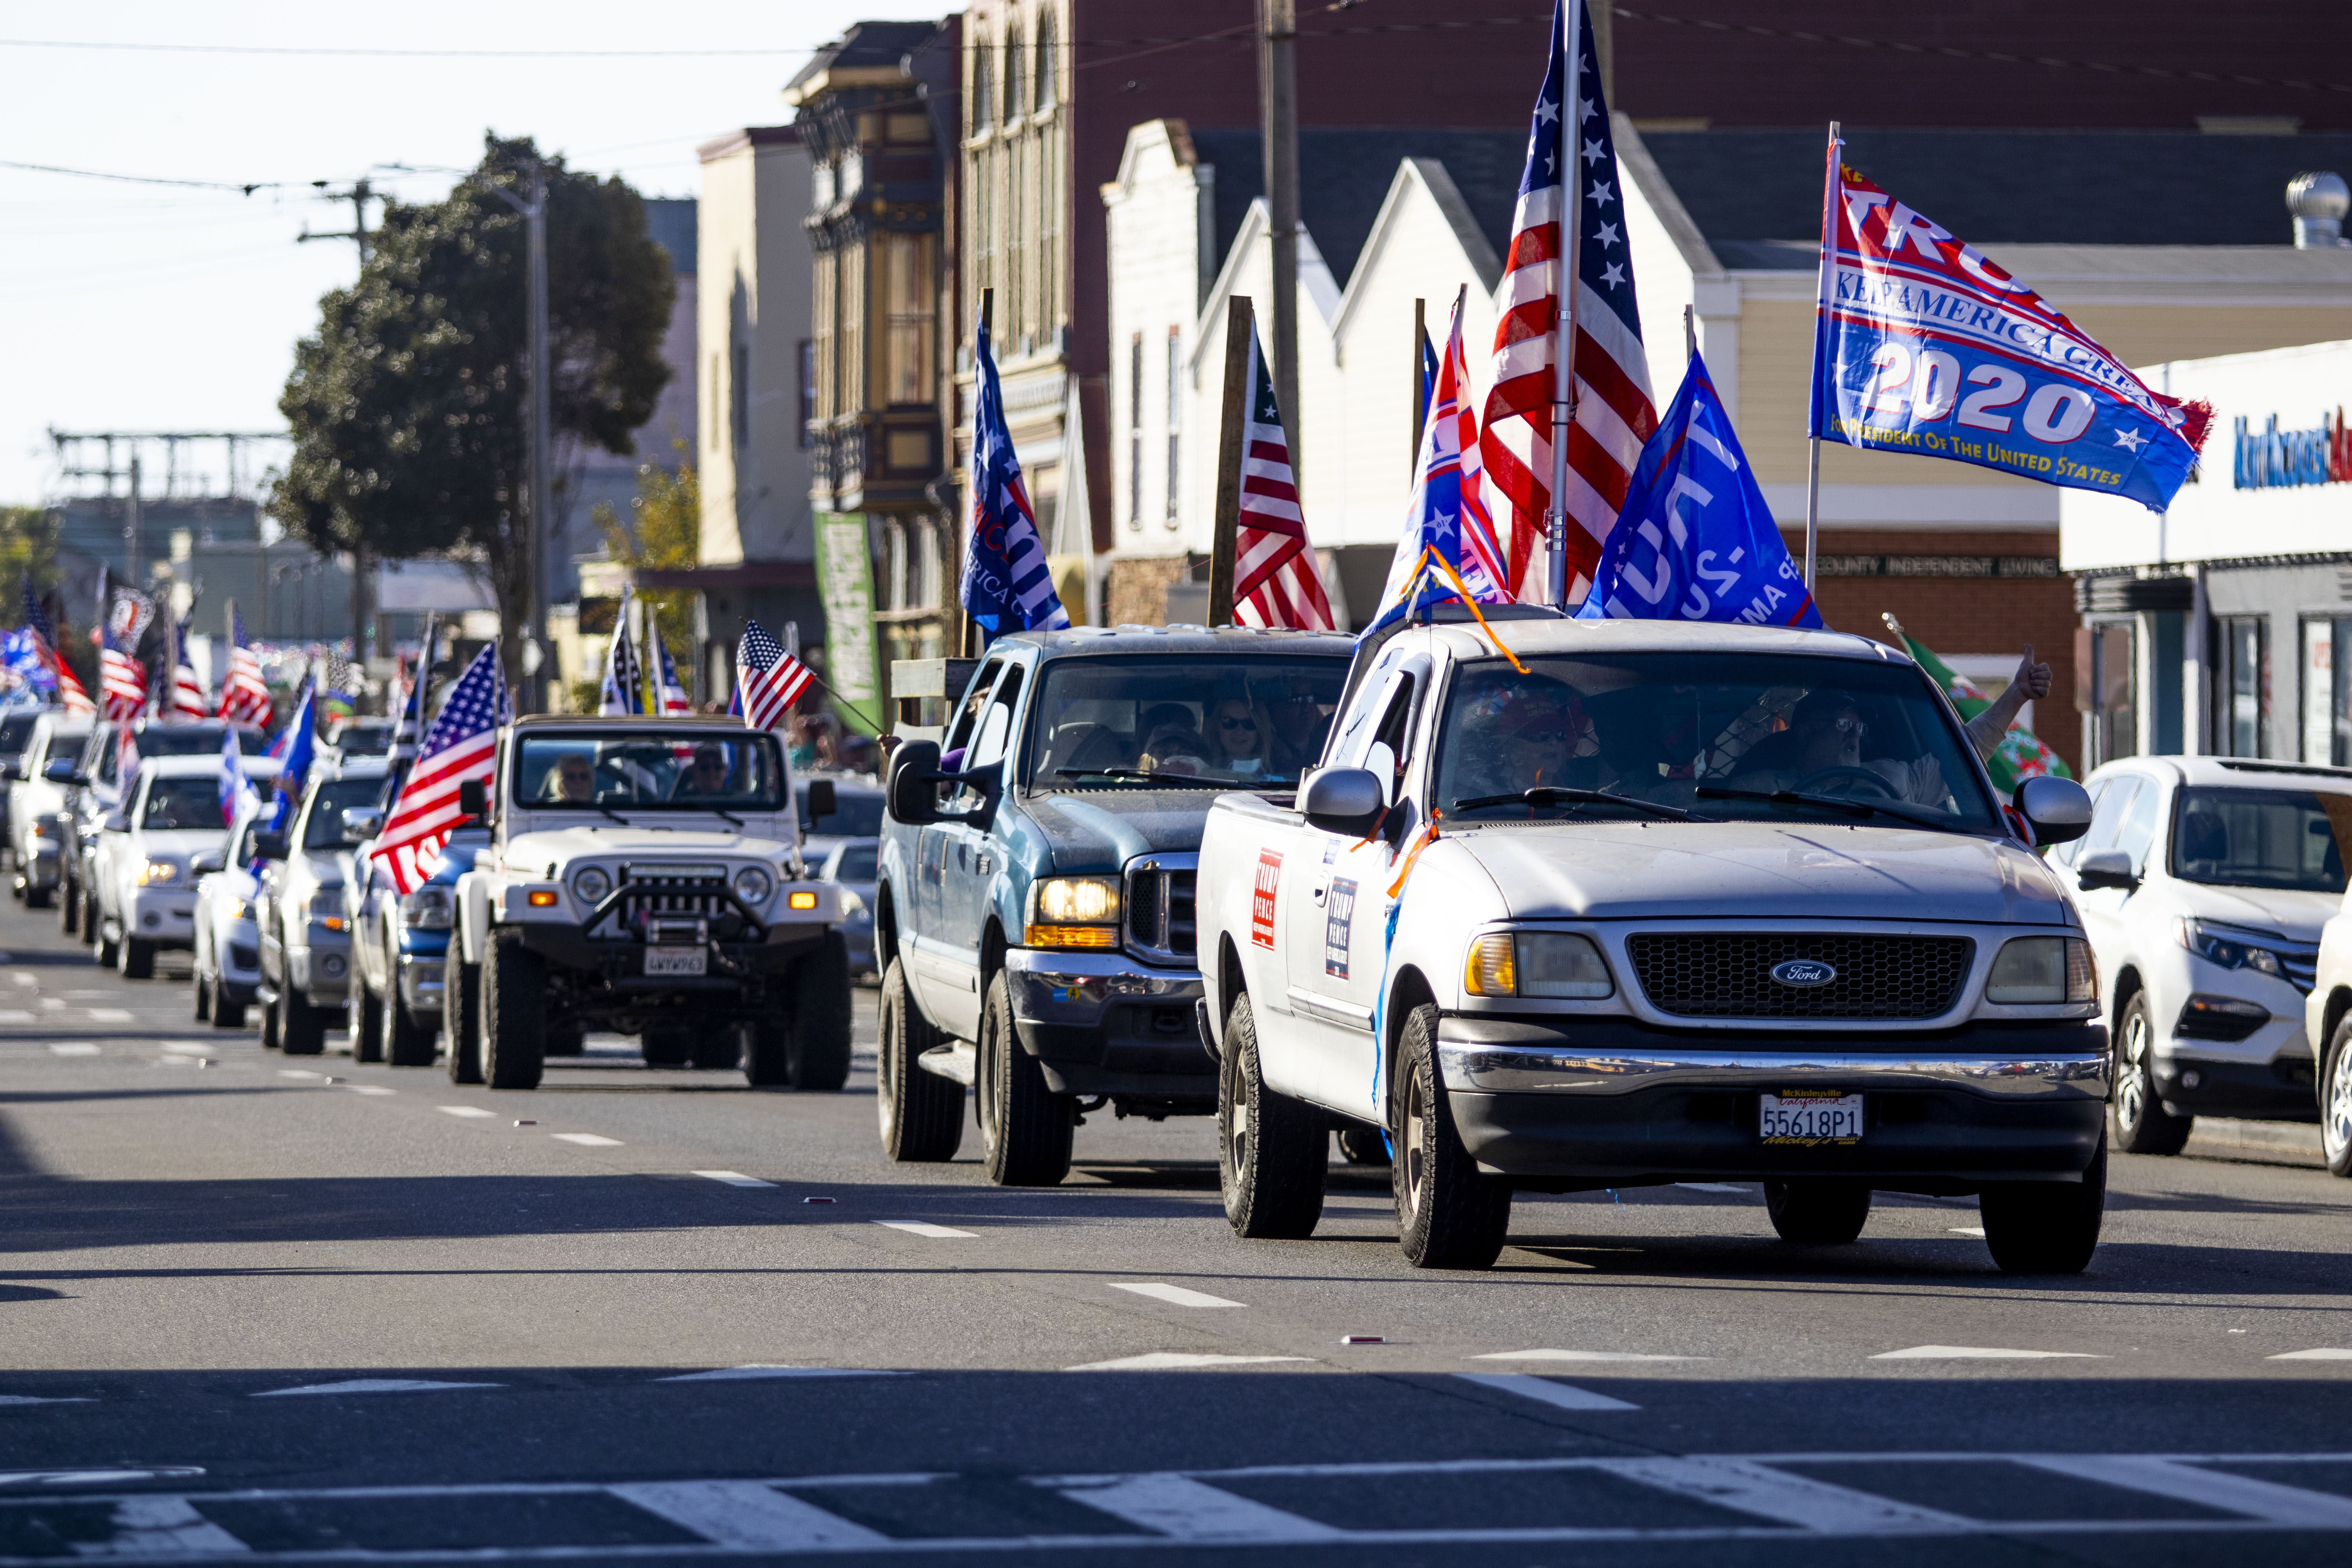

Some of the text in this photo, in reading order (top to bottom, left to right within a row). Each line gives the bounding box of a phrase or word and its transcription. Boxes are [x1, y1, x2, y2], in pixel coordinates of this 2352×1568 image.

[1837, 270, 1893, 308] KEEP
[1896, 284, 2053, 355] AMERICA
[1859, 343, 2097, 445] 2020
[1256, 862, 1279, 894] TRUMP
[1254, 896, 1273, 921] PENCE
[1330, 891, 1353, 921] TRUMP
[1329, 923, 1347, 947] PENCE
[1788, 965, 1821, 980] Ford
[1779, 1098, 1846, 1109] California
[1764, 1111, 1858, 1136] 55618P1
[1763, 1136, 1832, 1147] Mickey's
